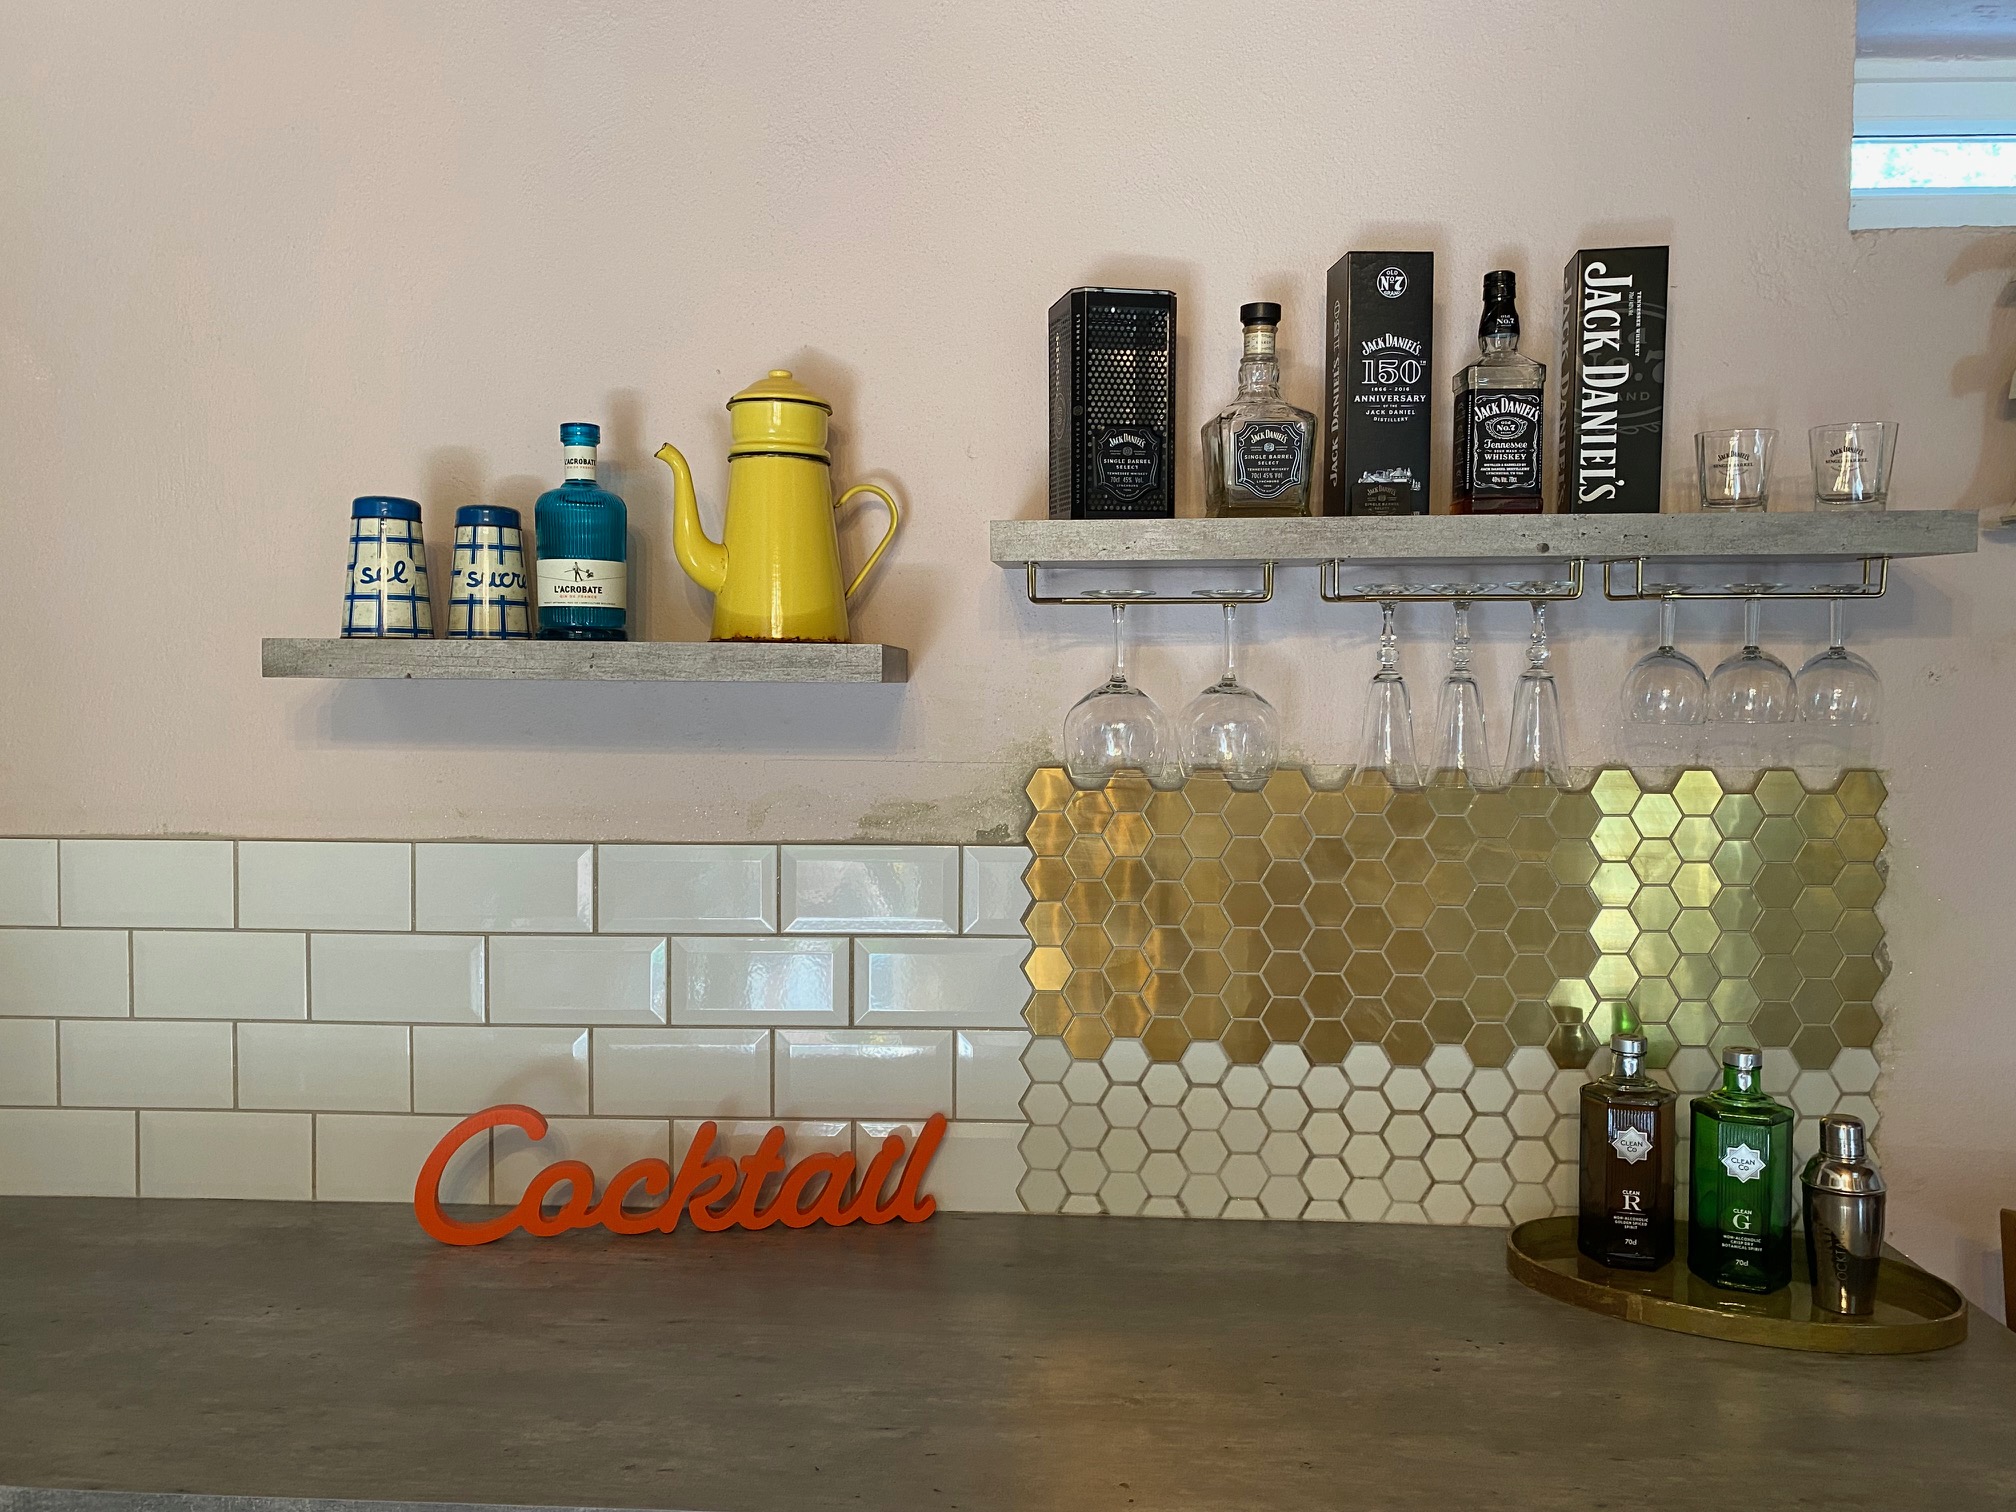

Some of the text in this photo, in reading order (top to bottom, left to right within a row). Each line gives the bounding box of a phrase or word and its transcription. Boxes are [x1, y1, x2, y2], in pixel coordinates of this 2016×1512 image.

[1361, 333, 1422, 357] JACK DANIEL'S
[1579, 261, 1633, 502] JACK DANIEL'S
[1353, 394, 1427, 403] ANNIVERSARY
[1474, 397, 1541, 422] JACK DANIEL'S
[1496, 424, 1516, 432] No.7
[1108, 435, 1124, 448] JACK
[1250, 431, 1266, 444] JACK
[1483, 438, 1528, 449] Tennessee
[1330, 436, 1339, 487] JACK
[360, 560, 409, 584] sel
[553, 585, 603, 594] L'ACROBATE
[1620, 1139, 1643, 1147] CLEAN
[1730, 1157, 1756, 1165] CLEAN
[413, 1103, 947, 1247] Cocktail
[1622, 1195, 1642, 1212] R
[1732, 1213, 1752, 1230] G
